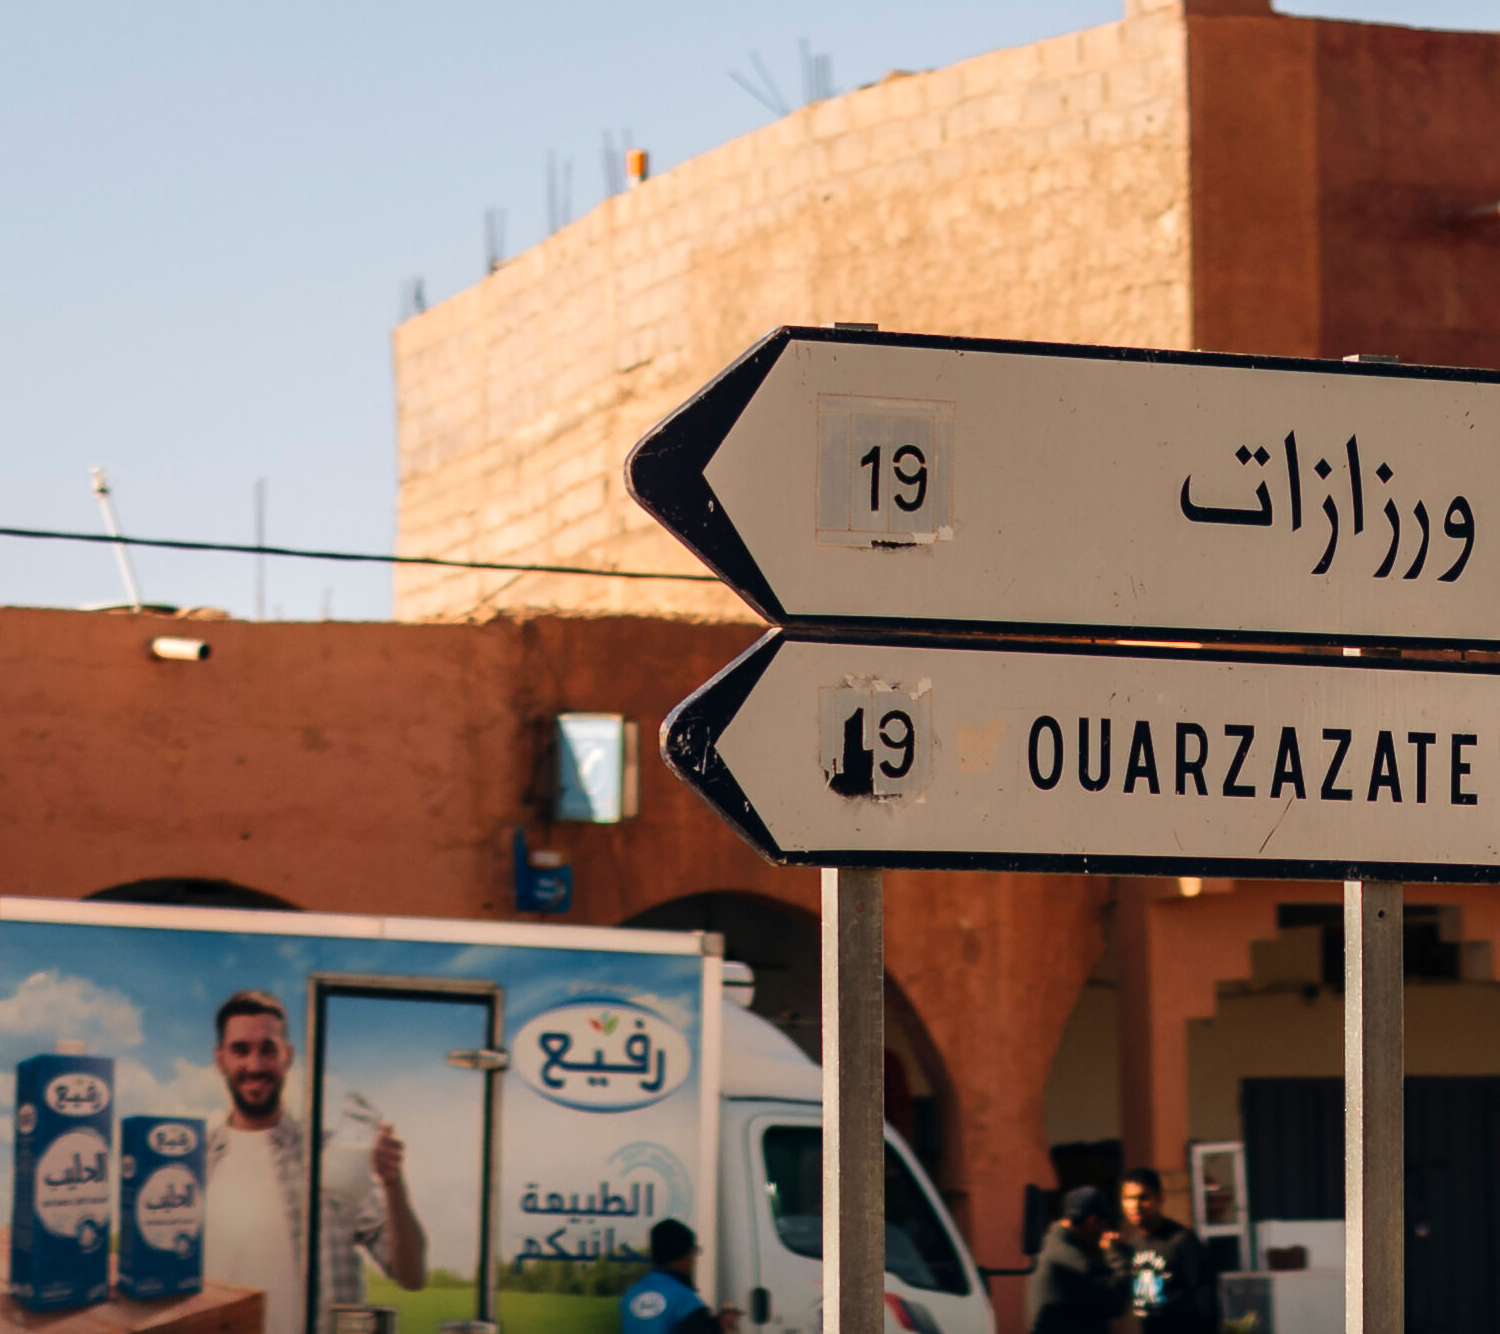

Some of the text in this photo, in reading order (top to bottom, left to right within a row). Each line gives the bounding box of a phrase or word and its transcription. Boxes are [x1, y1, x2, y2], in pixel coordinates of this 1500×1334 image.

[860, 429, 1475, 583] ورزازات 19
[840, 707, 1478, 806] 19 OUARZAZATE
[538, 1019, 667, 1093] رفيع
[519, 1180, 655, 1225] الطبيعة
